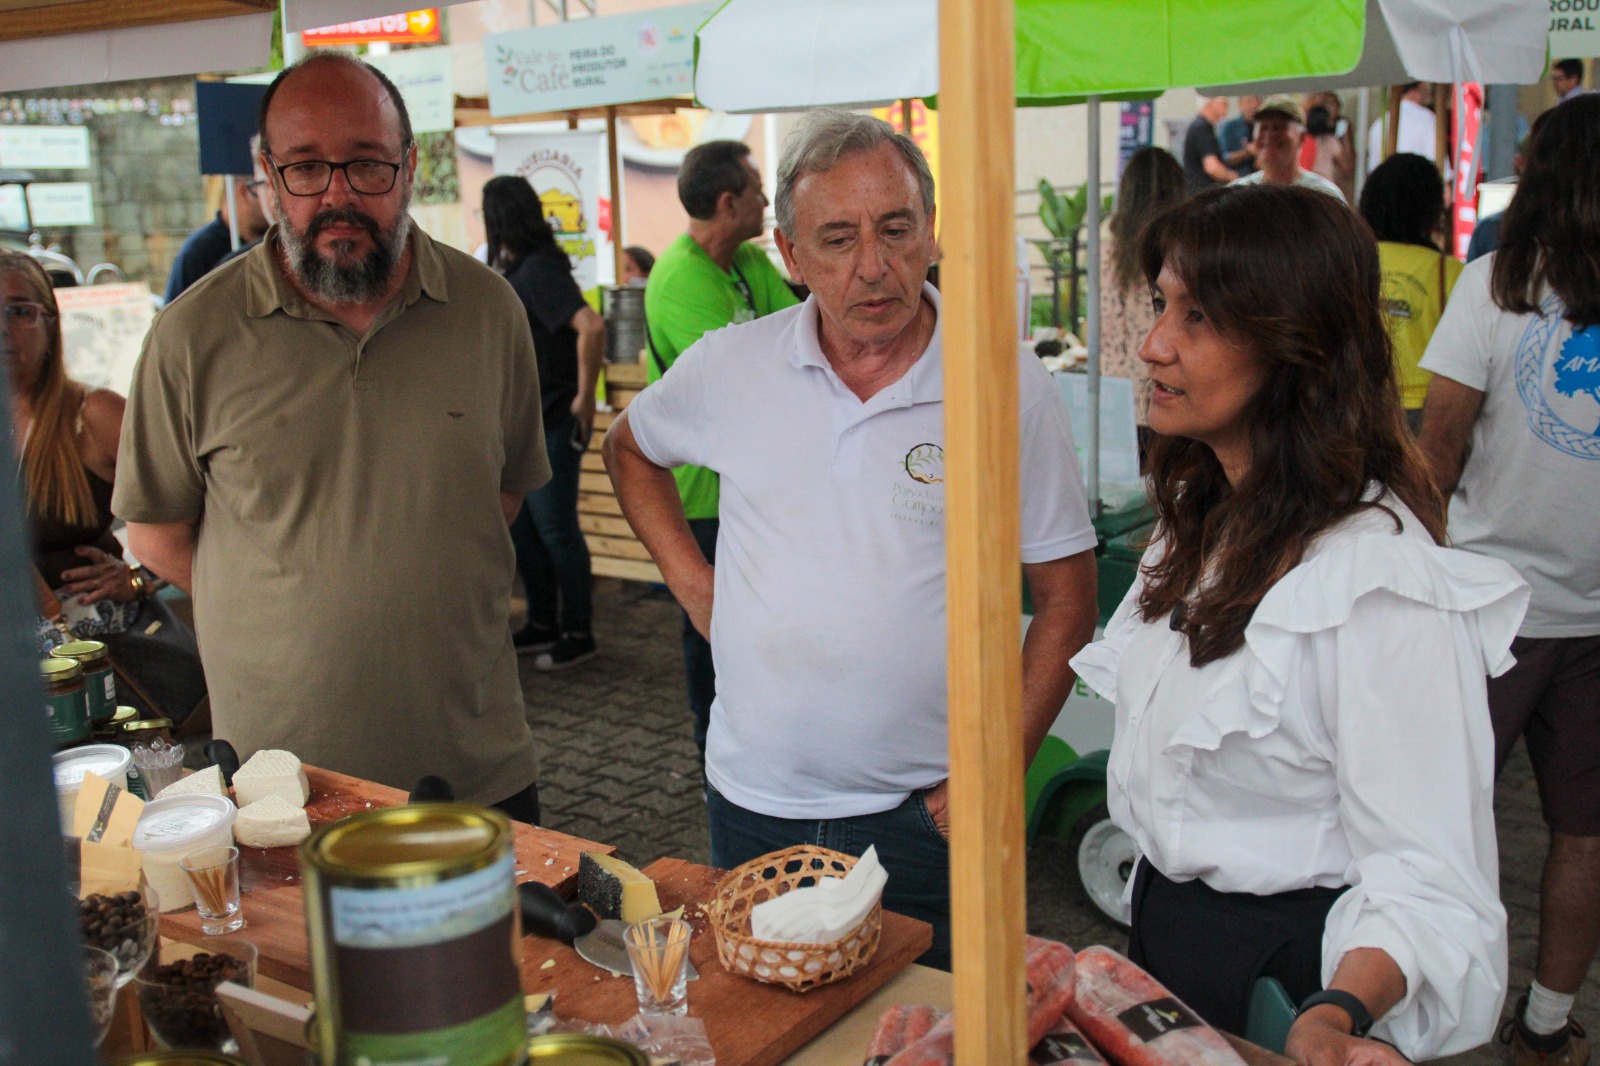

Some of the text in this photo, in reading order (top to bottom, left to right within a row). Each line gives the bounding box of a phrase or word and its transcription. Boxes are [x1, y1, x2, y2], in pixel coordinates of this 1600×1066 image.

[569, 44, 616, 60] FEIRA DO
[571, 57, 628, 73] PRODUTOR
[519, 63, 571, 93] Café
[572, 74, 607, 88] RURAL
